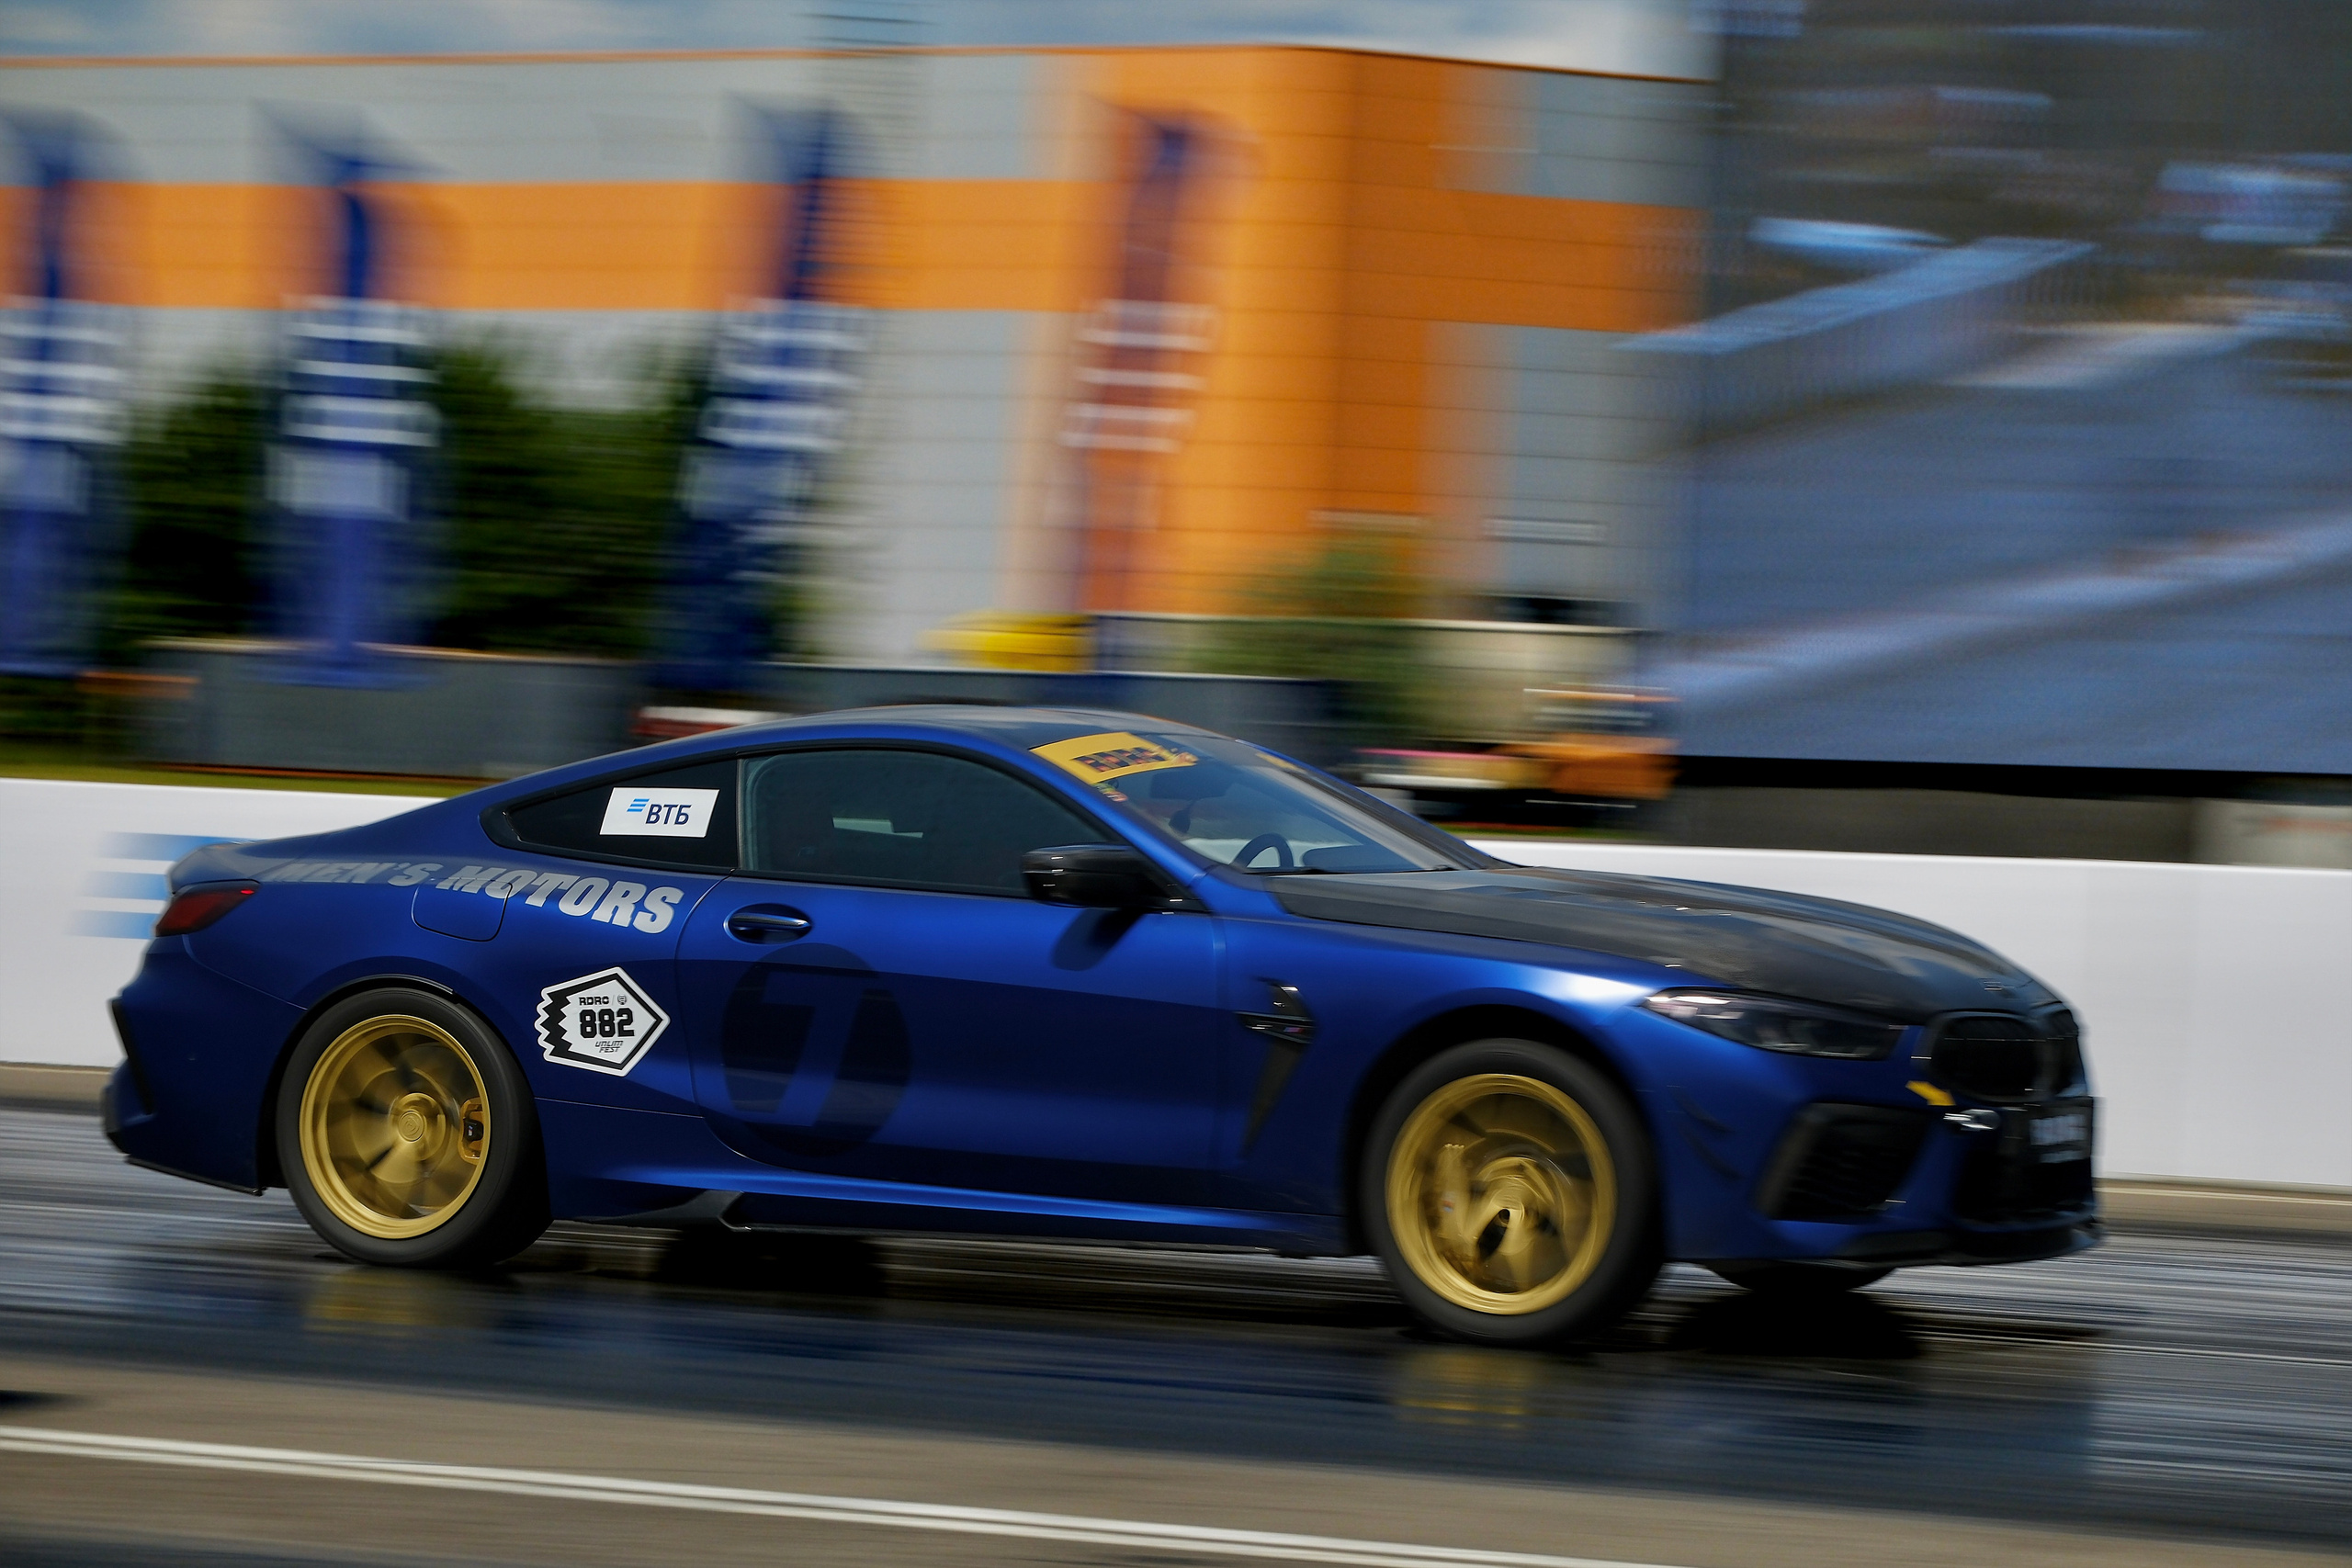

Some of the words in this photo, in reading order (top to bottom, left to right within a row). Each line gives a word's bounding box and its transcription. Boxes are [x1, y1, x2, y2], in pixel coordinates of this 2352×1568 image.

[645, 804, 692, 825] ВТБ
[435, 864, 685, 934] MOTORS
[579, 996, 610, 1006] RDRC
[579, 1008, 635, 1039] 882
